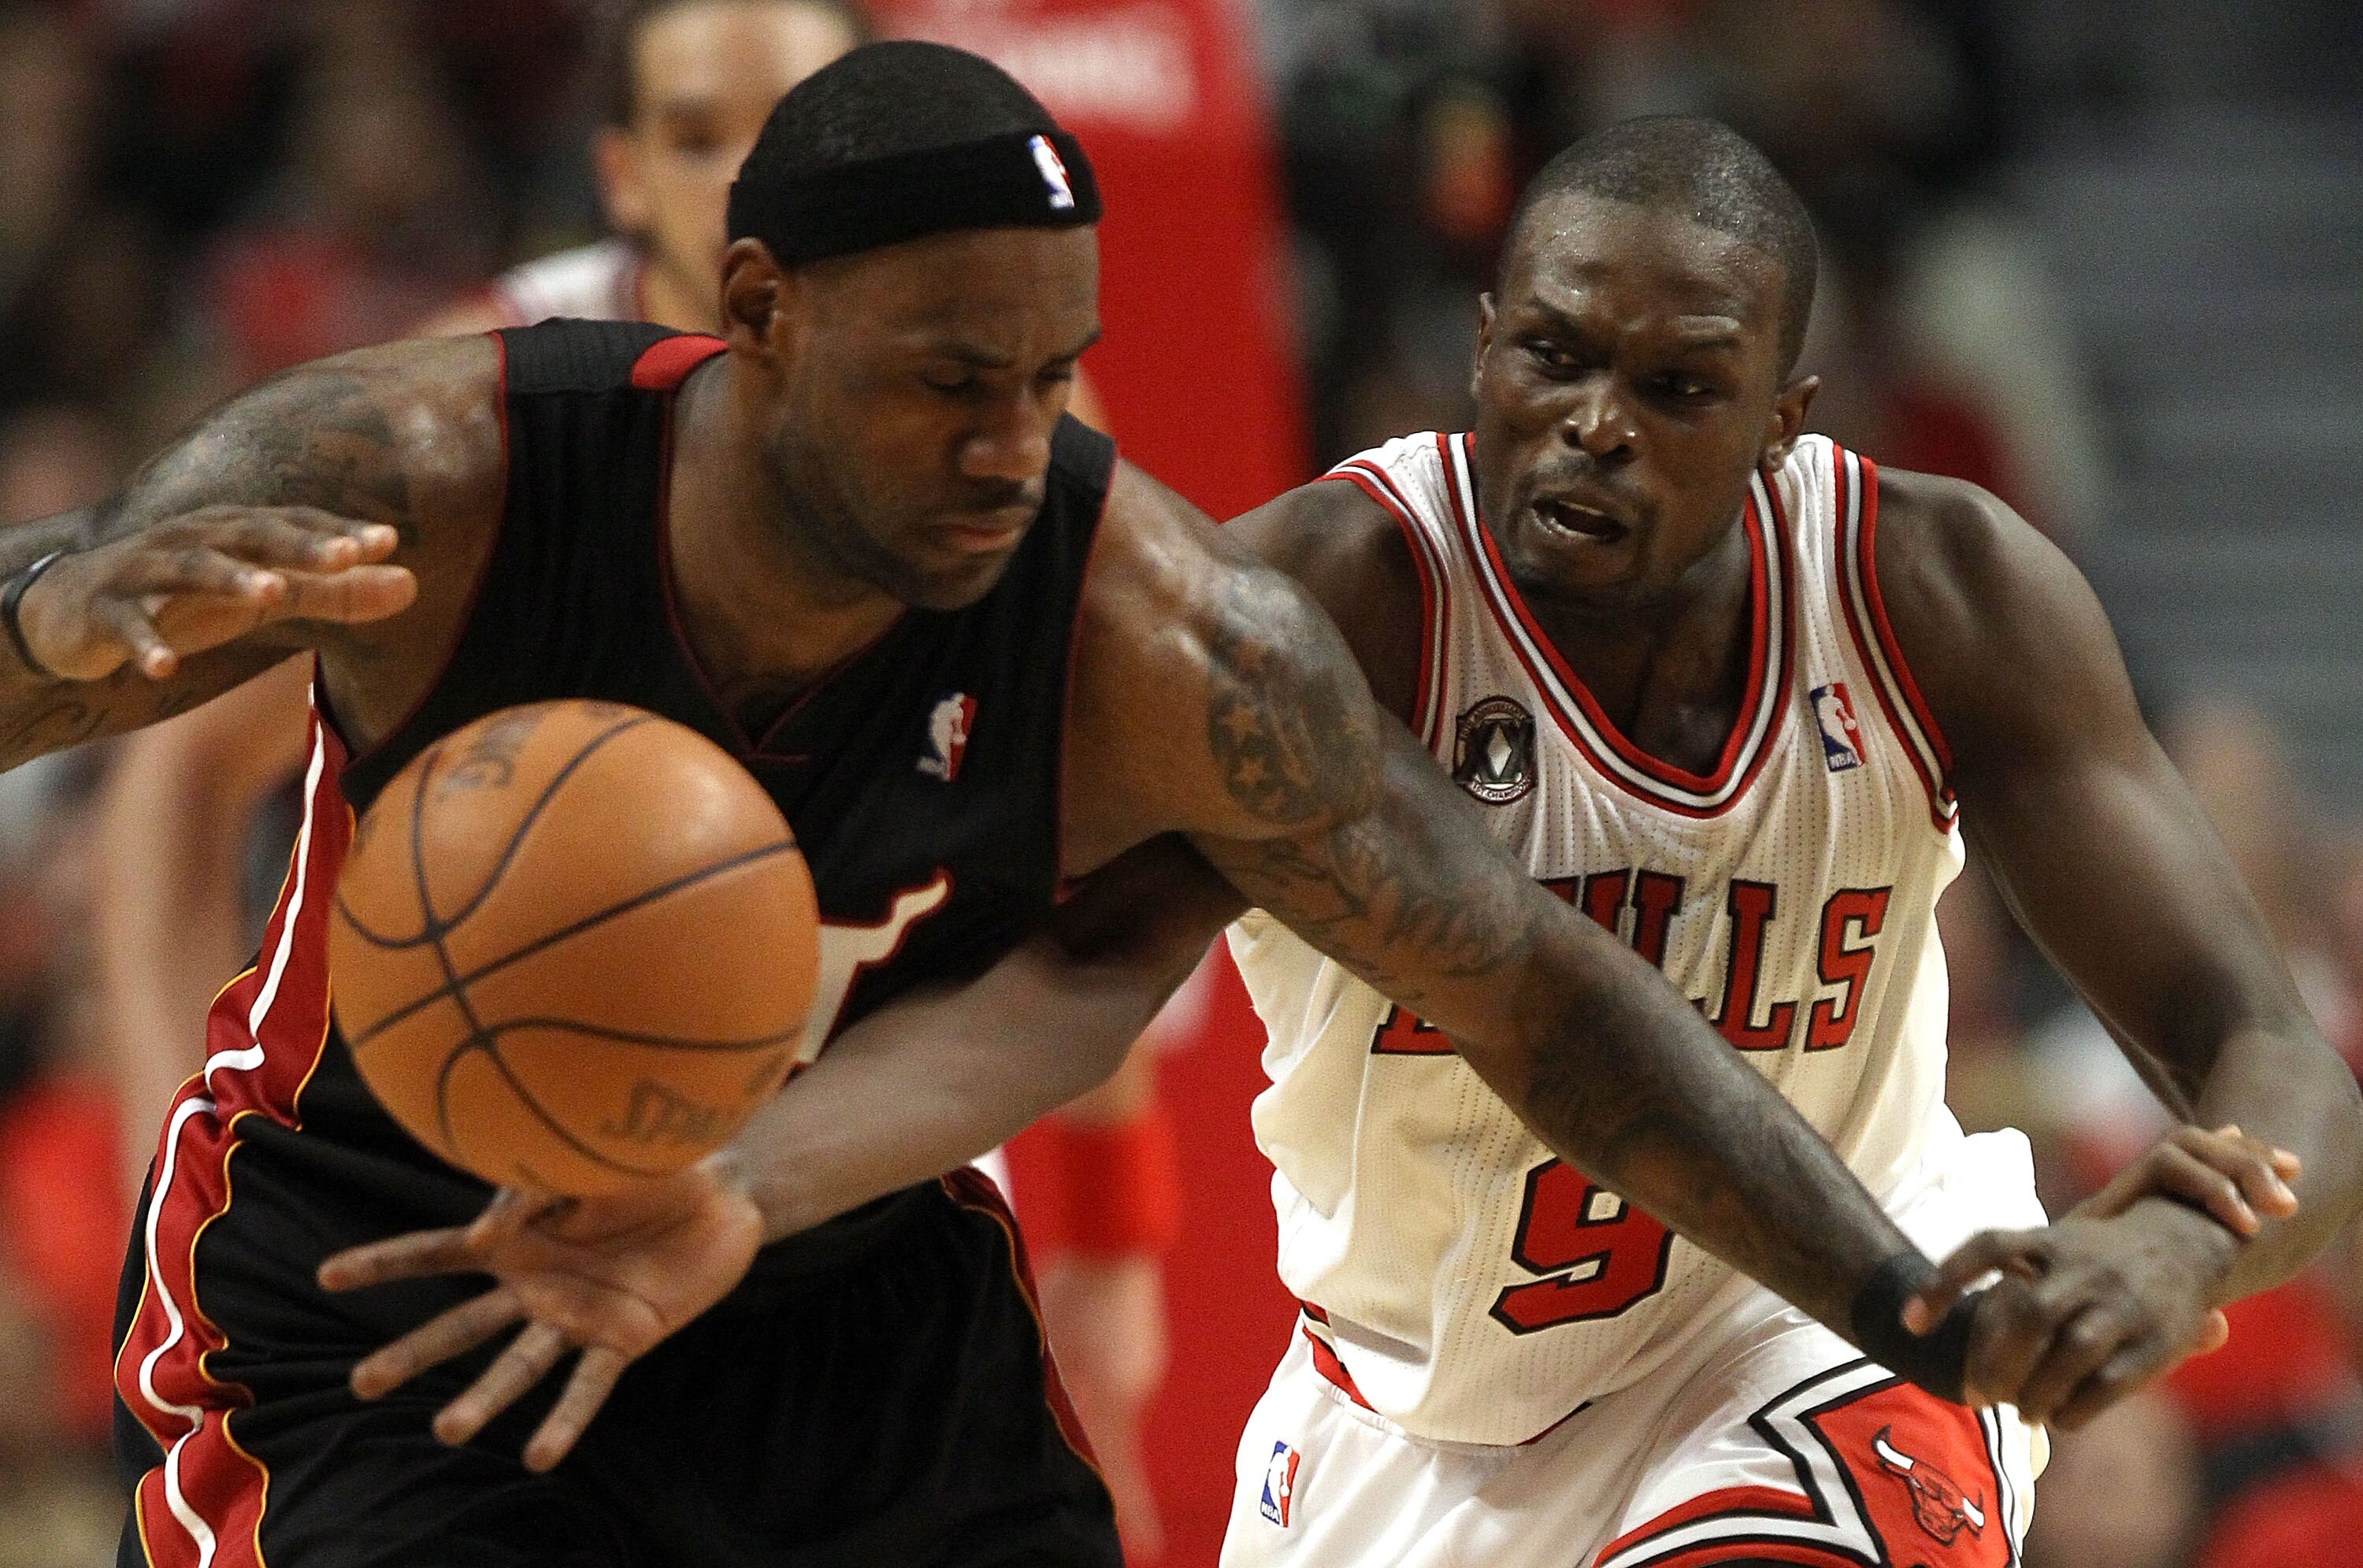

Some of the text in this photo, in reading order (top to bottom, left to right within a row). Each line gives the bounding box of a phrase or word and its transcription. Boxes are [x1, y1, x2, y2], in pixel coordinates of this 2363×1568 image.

[1371, 868, 1893, 1055] LLS
[1488, 1155, 1675, 1336] 9
[1261, 1501, 1279, 1522] NBA
